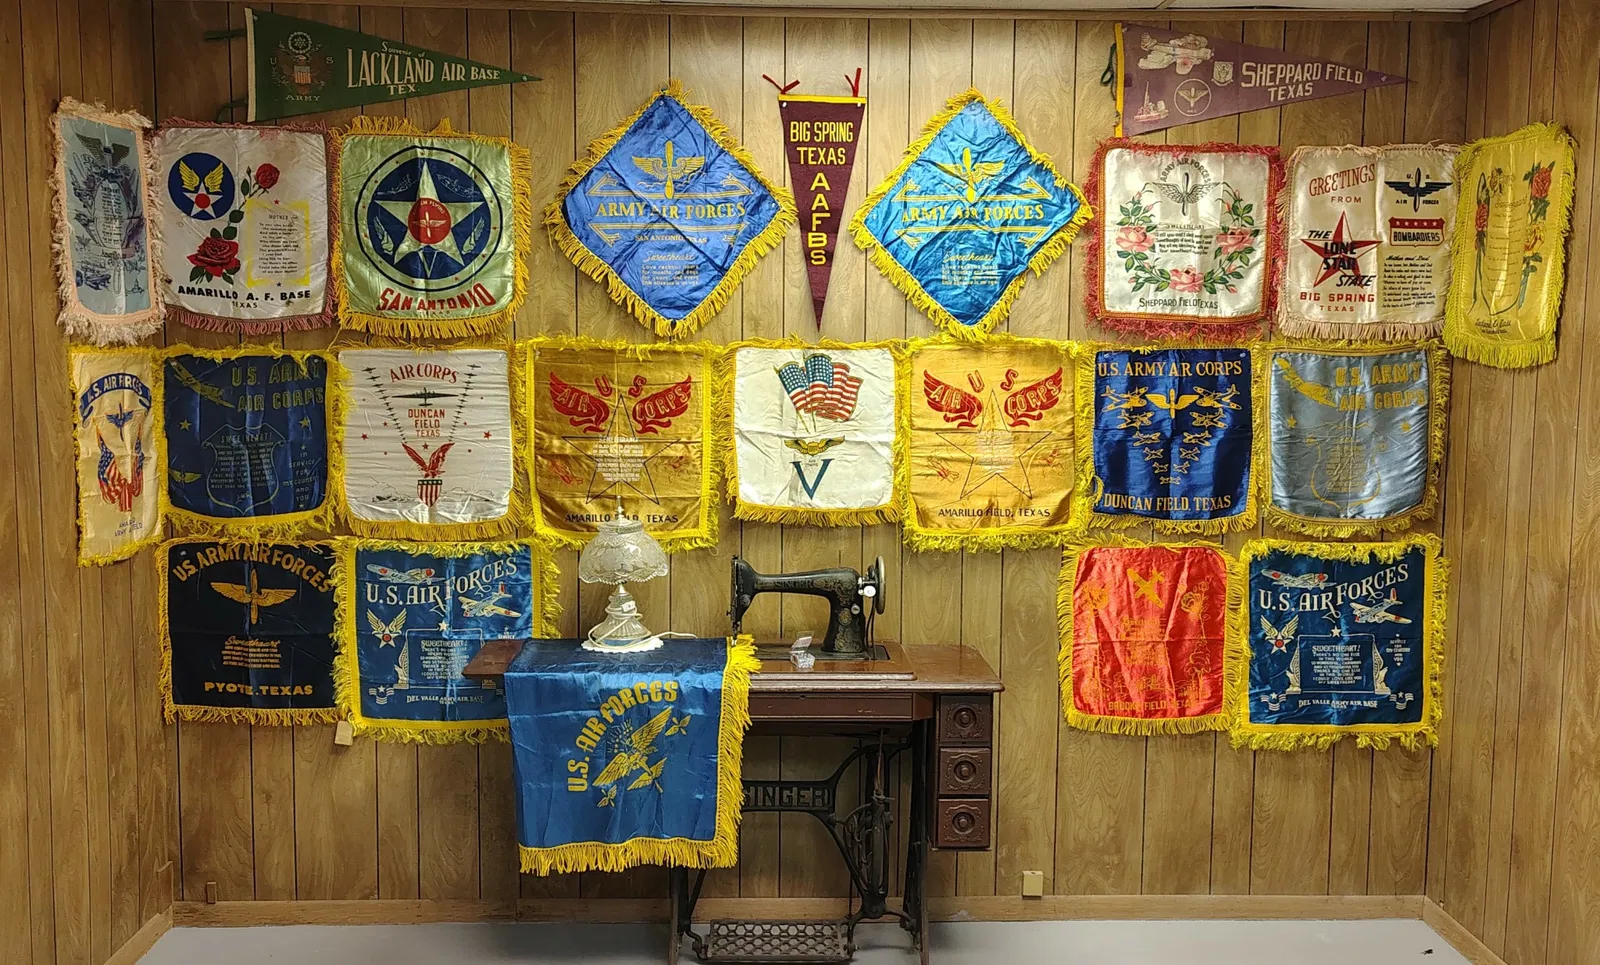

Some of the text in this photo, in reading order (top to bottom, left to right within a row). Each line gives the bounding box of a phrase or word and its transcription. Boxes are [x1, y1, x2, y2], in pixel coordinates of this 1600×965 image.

[381, 41, 412, 56] Souvenir
[269, 56, 334, 65] U S
[347, 48, 501, 88] LACKLAND AIR BASE
[1240, 61, 1364, 88] SHEPPARD FIELD
[387, 83, 421, 96] TEX.
[1267, 82, 1314, 103] TEXAS
[285, 94, 320, 102] ARMY
[790, 121, 854, 143] BIG SPRING
[796, 146, 846, 166] TEXAS
[1160, 157, 1212, 183] ARMY AIR FORCES
[1309, 163, 1376, 198] GREETINGS
[1330, 195, 1362, 204] FROM
[595, 201, 746, 220] ARMY AIR FORCES
[902, 204, 1045, 223] ARMY AIR FORCES
[1308, 230, 1333, 239] THE
[1393, 231, 1440, 242] BOMBARDIERS
[1324, 241, 1357, 255] LONE
[1323, 257, 1358, 271] STAR
[1336, 274, 1377, 287] STATE
[178, 285, 311, 301] AMARILLO A. F. BASE
[375, 282, 497, 311] SAN ANTONIO
[1299, 291, 1375, 303] BIG SPRING
[232, 300, 258, 308] TEXAS
[1139, 296, 1218, 309] SHEPPARD FIELD TEXAS
[1319, 304, 1355, 312] TEXAS
[231, 366, 260, 387] U.S.
[389, 363, 460, 384] AIR CORPS
[1098, 363, 1121, 377] U.S.
[1124, 361, 1167, 377] ARMY
[1195, 360, 1243, 377] CORPS
[1371, 362, 1423, 386] ARMY
[103, 375, 117, 391] AIR
[594, 374, 648, 398] U S
[967, 368, 1019, 393] U S
[237, 387, 325, 412] AIR CORPS
[557, 384, 689, 421] AIR CORPS
[929, 378, 1060, 415] AIR CORPS
[1338, 389, 1427, 412] AIR CORPS
[407, 408, 446, 419] DUNCAN
[414, 419, 441, 429] FIELD
[415, 429, 441, 438] TEXAS
[790, 458, 835, 500] V
[1104, 493, 1152, 511] DUNCAN
[1193, 494, 1232, 511] TEXAS
[565, 513, 679, 524] AMARILLO TEXAS
[938, 508, 983, 517] AMARILLO
[1018, 508, 1051, 517] TEXAS
[172, 559, 199, 582] U.S.
[196, 545, 241, 570] ARMY
[271, 549, 334, 593] FORCES
[366, 556, 518, 616] U.S. AIR FORCES
[774, 579, 814, 589] SINGER
[1258, 563, 1409, 623] U.S. AIR FORCES
[225, 635, 281, 648] Sweetheart
[259, 684, 314, 696] TEXAS
[406, 695, 420, 704] DEL
[469, 695, 484, 703] BASE
[1144, 700, 1168, 711] FIELD
[1298, 699, 1311, 708] DEL
[1363, 700, 1378, 708] BASE
[567, 680, 679, 792] U.S. AIR FORCES
